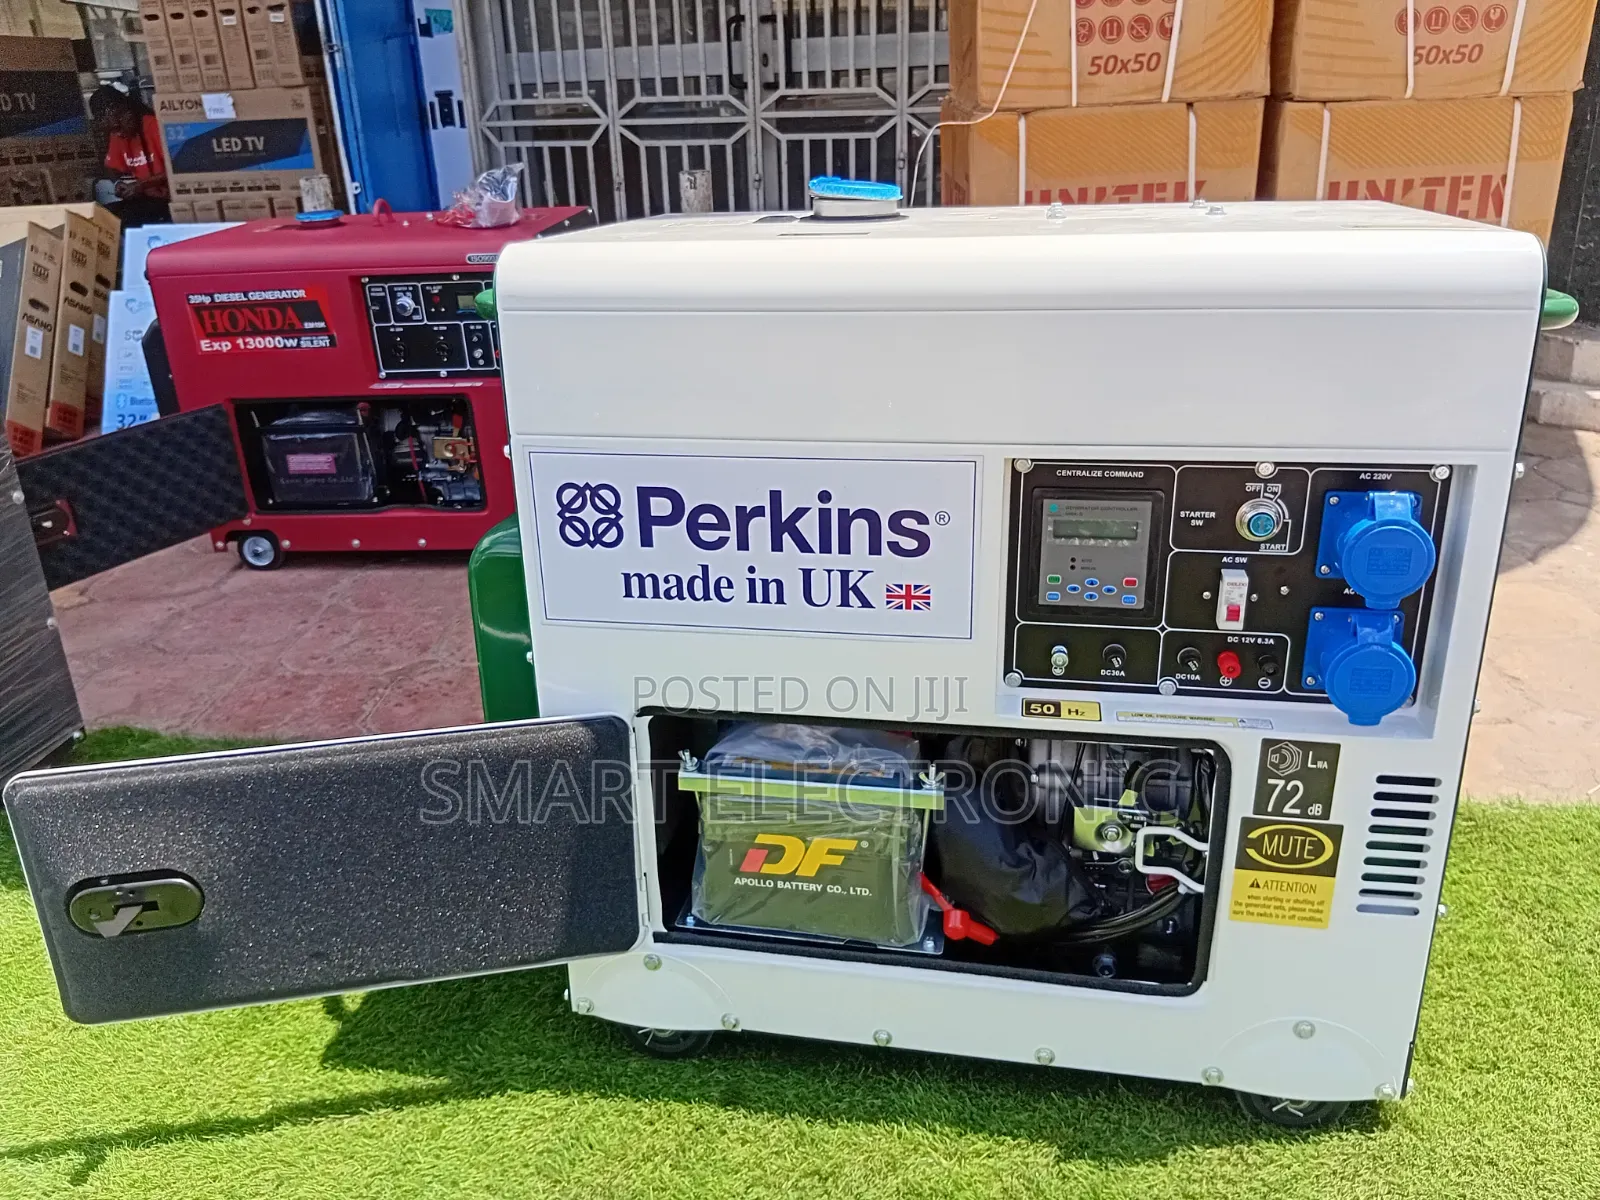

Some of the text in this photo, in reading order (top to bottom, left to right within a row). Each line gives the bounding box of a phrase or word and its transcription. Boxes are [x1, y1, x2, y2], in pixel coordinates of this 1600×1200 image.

[1413, 43, 1484, 66] 50x50
[1087, 51, 1161, 76] 50x50
[13, 92, 36, 112] TV
[212, 136, 264, 152] LED TV
[213, 292, 248, 302] DIESEL
[248, 289, 306, 300] GENERATOR
[63, 296, 93, 315] ASANO
[22, 312, 53, 332] ASANO
[201, 305, 304, 333] HONDA
[200, 336, 298, 352] Exp 13000w
[300, 339, 331, 348] SILENT
[1056, 469, 1144, 478] CENTRALIZE COMMAND
[1359, 472, 1370, 480] AC
[1245, 485, 1279, 493] OFF ON
[1180, 510, 1216, 519] STARTER
[1260, 543, 1287, 551] START
[1234, 556, 1248, 564] SW
[622, 564, 876, 610] made in UK
[1100, 669, 1126, 677] DC30A
[1175, 673, 1201, 681] DC10A
[1029, 703, 1086, 717] 50 Hz
[1266, 778, 1323, 816] 72 dB
[1262, 833, 1318, 860] MUTE
[734, 876, 872, 897] APOLLO BATTERY CO., LTD.
[1262, 879, 1317, 894] ATTENTION
[1244, 901, 1271, 909] generator
[1262, 895, 1284, 904] starting
[1293, 897, 1315, 906] shutting
